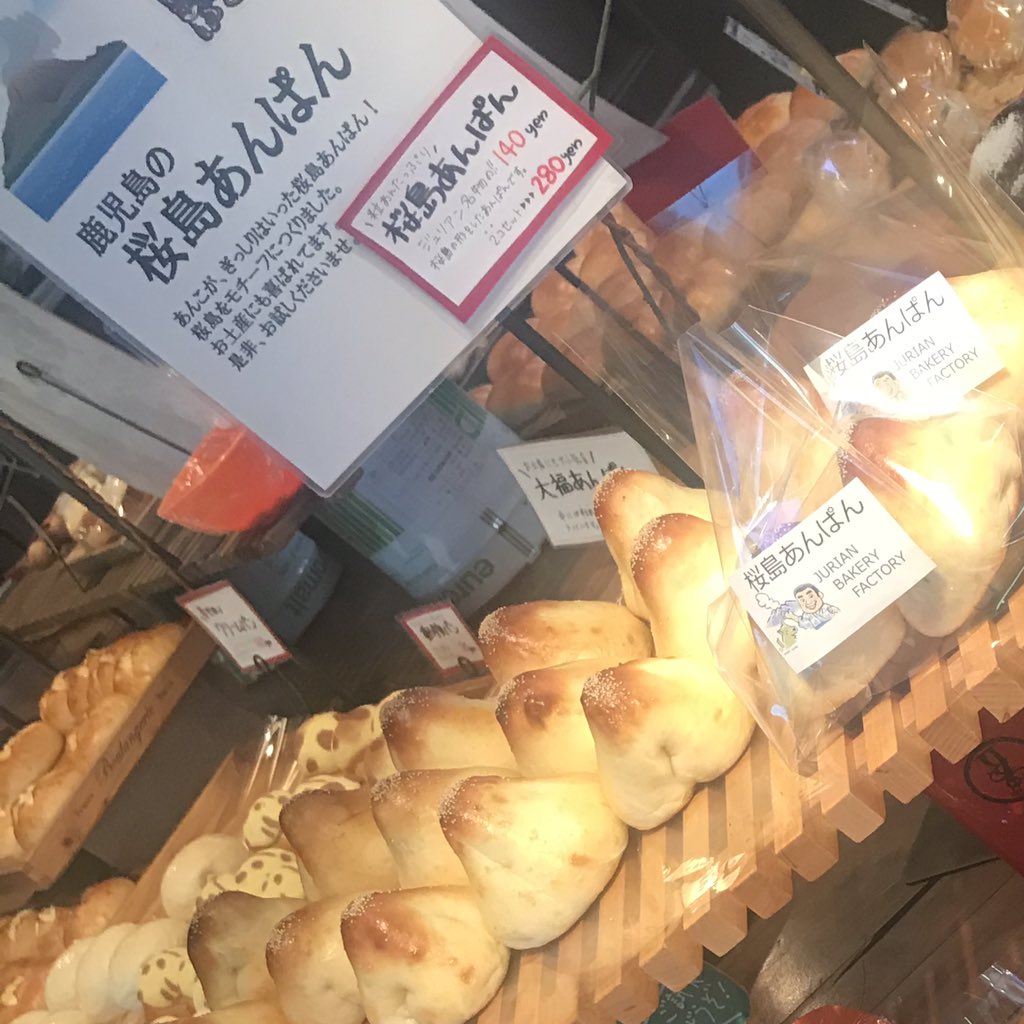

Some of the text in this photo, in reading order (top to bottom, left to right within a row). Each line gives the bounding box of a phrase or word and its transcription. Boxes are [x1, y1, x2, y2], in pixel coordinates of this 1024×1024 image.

[126, 43, 352, 285] 桜島あんぱん
[381, 85, 519, 244] 桜島あんぱん
[492, 129, 526, 167] 140
[524, 109, 549, 139] yen
[75, 146, 175, 257] 鹿児島の
[190, 185, 343, 342] 桜島をモチーフにつくりました。
[826, 289, 945, 376] 桜島あんぱん
[908, 342, 957, 381] BAKERY
[743, 498, 865, 594] 桜島あんぱん
[812, 543, 860, 585] JURIAN
[832, 549, 881, 592] BAKERY
[851, 551, 909, 599] FACTORY
